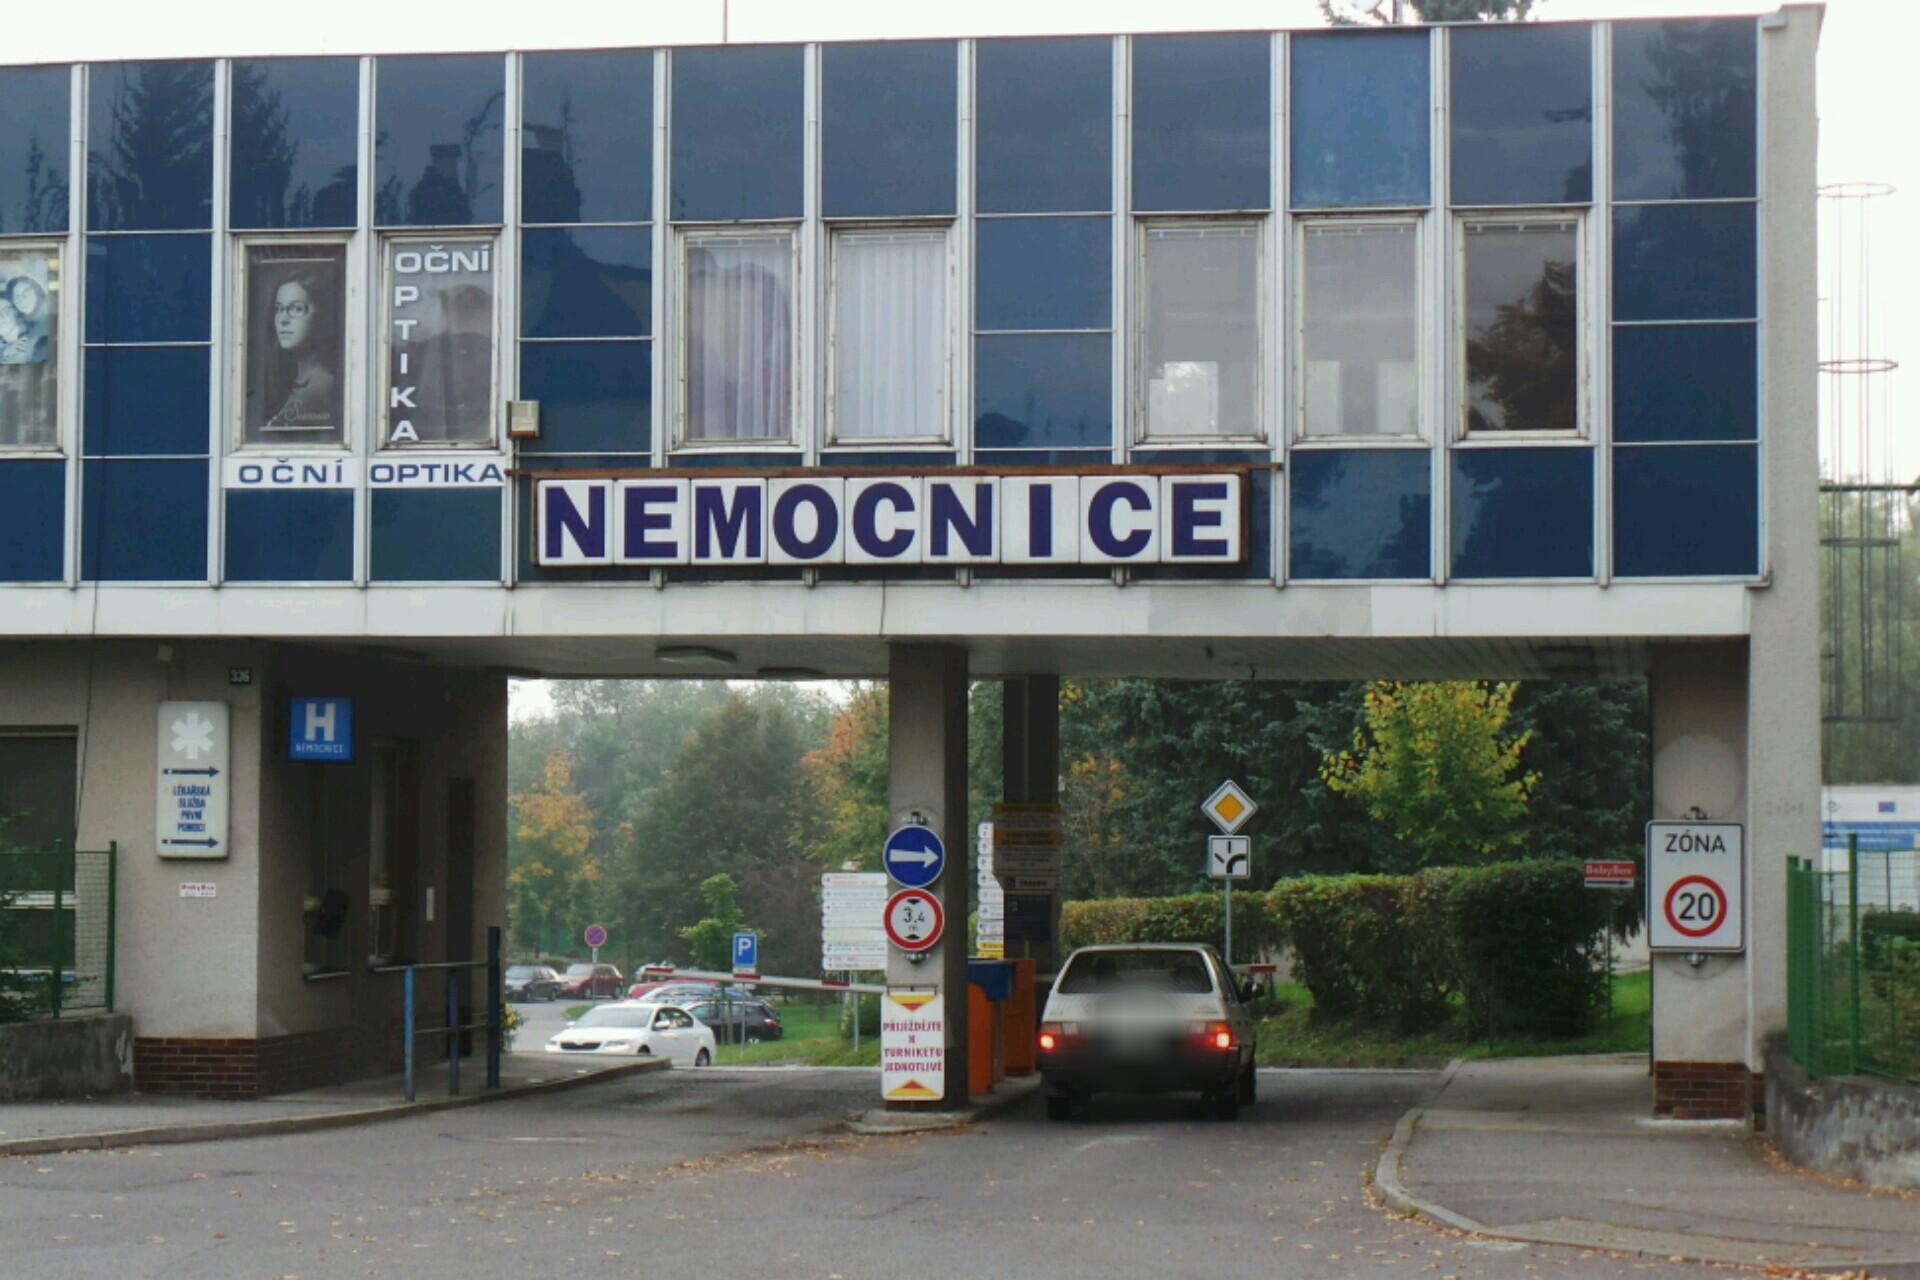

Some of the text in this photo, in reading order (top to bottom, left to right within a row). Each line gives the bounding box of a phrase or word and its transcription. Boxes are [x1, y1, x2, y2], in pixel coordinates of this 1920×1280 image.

[394, 243, 490, 273] OČNÍ
[238, 458, 504, 484] OČNÍ OPTIKA
[545, 481, 1229, 560] NEMOCNICE
[305, 702, 336, 741] H
[1664, 830, 1726, 853] ZÓNA
[1678, 892, 1715, 921] 20
[738, 937, 752, 956] P
[883, 1047, 943, 1058] TURNIKETU
